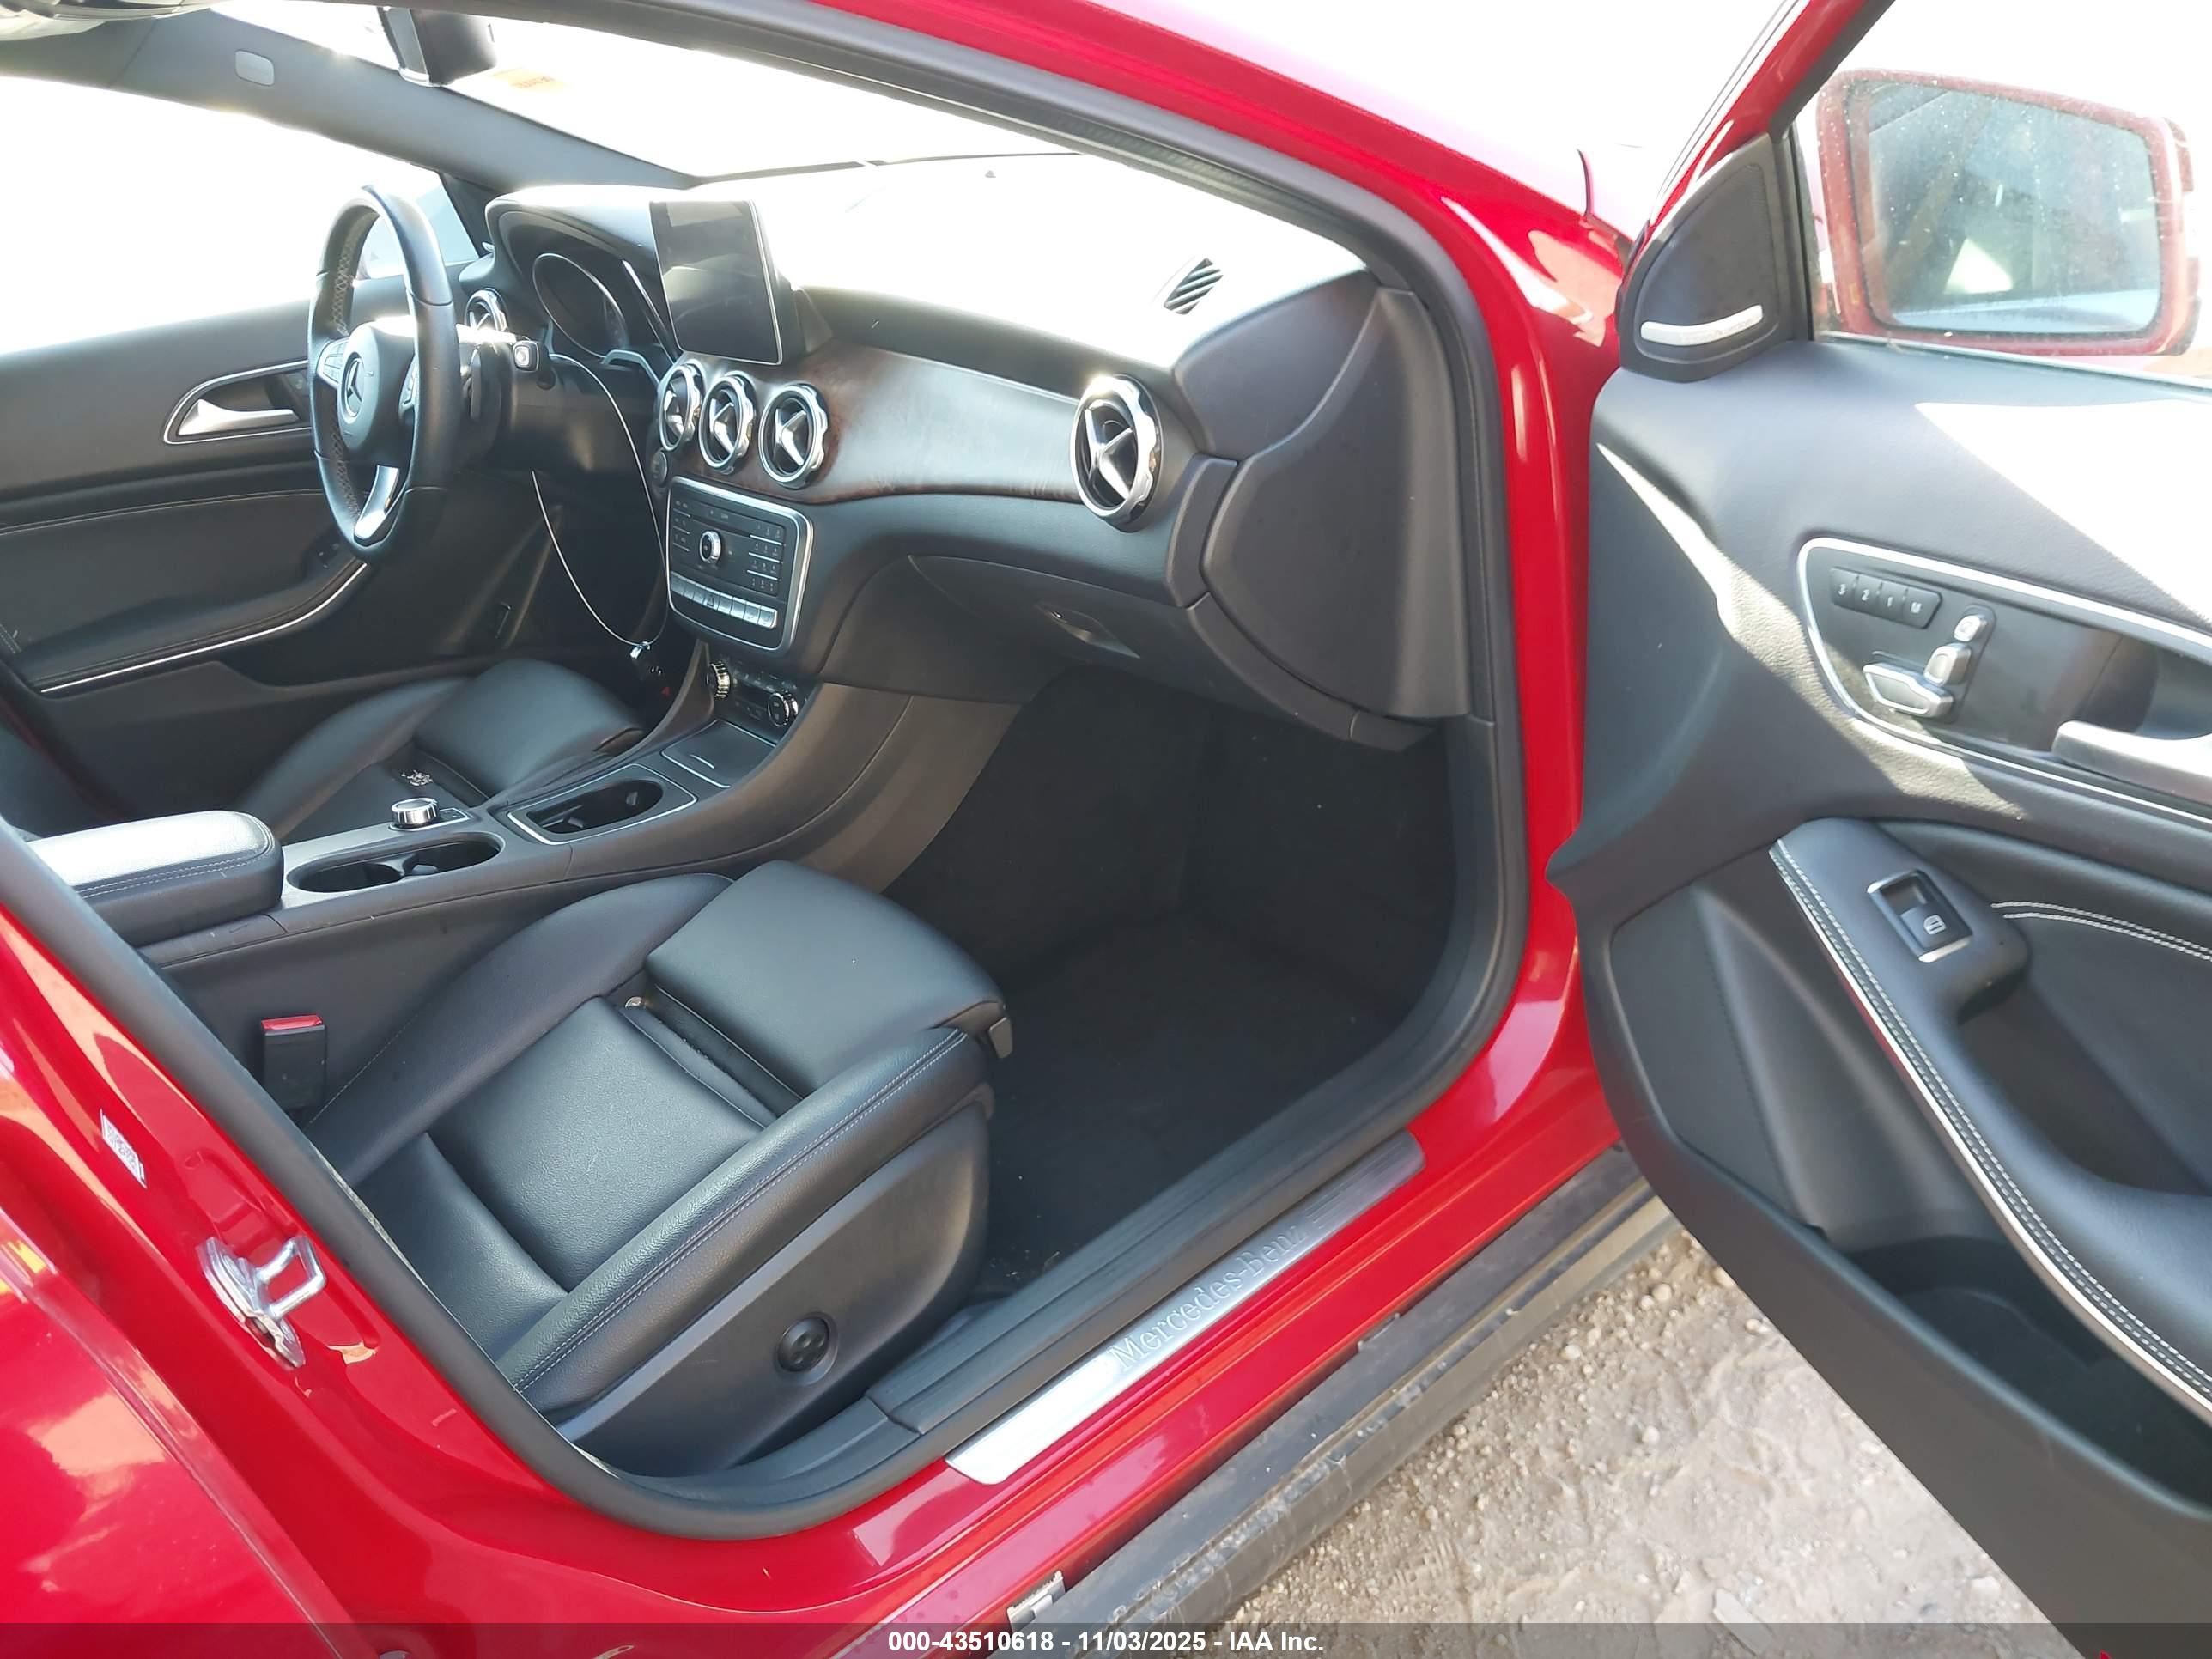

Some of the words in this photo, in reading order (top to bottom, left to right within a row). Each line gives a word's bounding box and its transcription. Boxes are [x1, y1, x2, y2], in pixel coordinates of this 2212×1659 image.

[1838, 584, 1846, 595] 3
[1862, 589, 1869, 600] 2
[1887, 597, 1893, 606] 1
[1107, 1224, 1309, 1372] Mercedes-Benz
